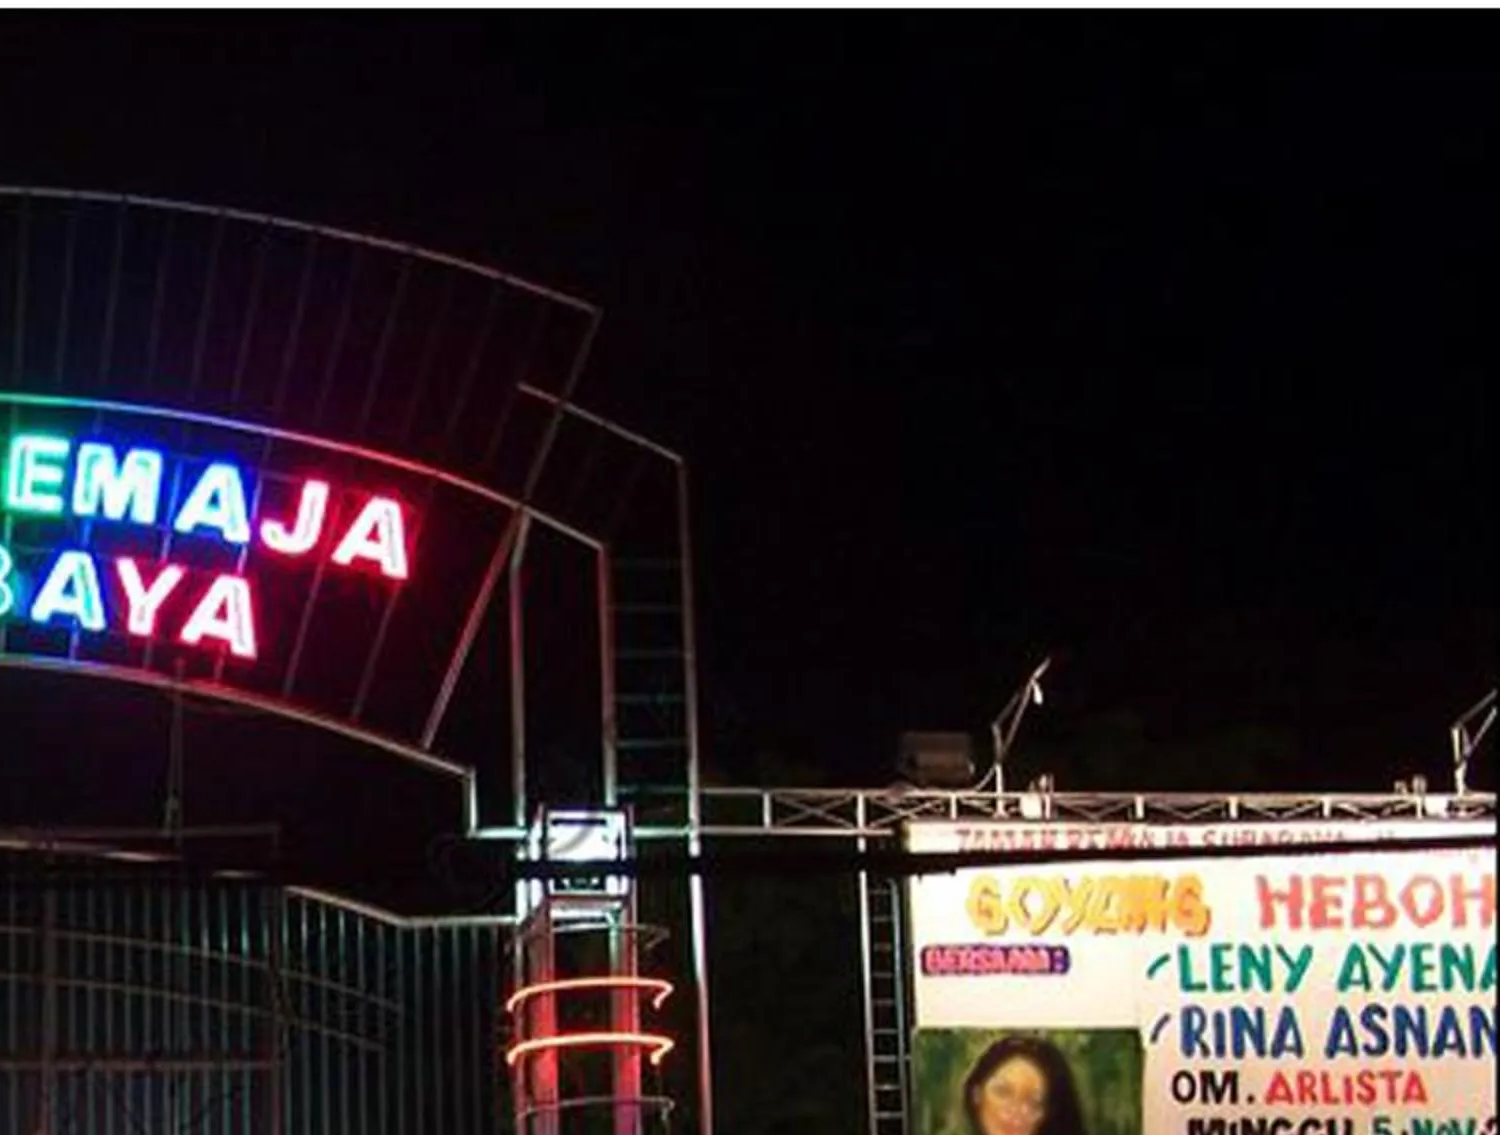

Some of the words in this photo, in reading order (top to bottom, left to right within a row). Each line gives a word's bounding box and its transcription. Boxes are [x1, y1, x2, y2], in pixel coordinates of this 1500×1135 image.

[1256, 874, 1496, 928] HEBOH
[1178, 943, 1313, 992] LENY
[1337, 943, 1496, 992] AYENA
[1180, 1004, 1304, 1058] RINA
[1326, 1003, 1496, 1058] ASNAN
[1171, 1070, 1255, 1105] OM.
[1263, 1070, 1428, 1105] ARLISTA
